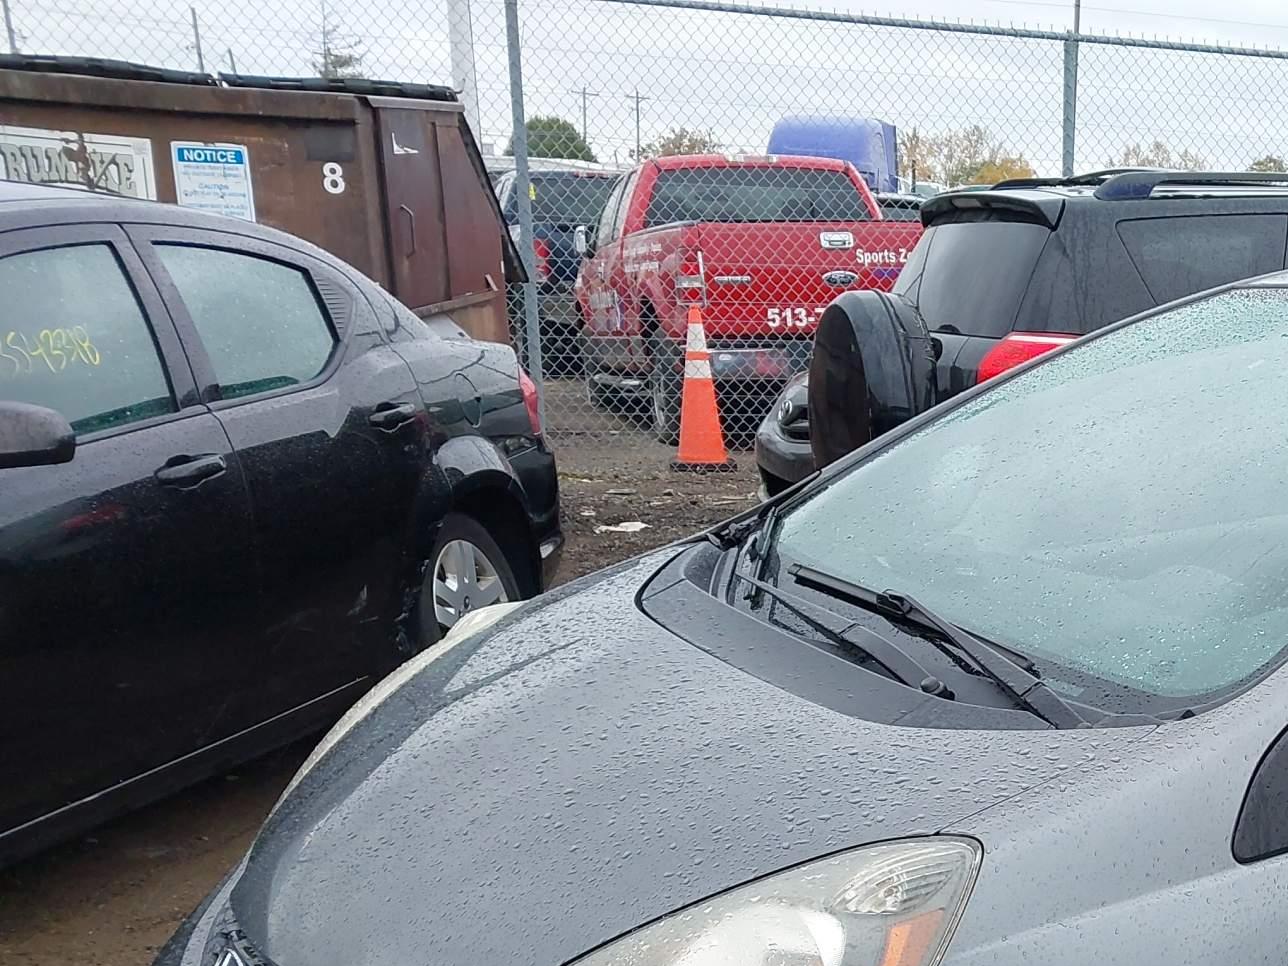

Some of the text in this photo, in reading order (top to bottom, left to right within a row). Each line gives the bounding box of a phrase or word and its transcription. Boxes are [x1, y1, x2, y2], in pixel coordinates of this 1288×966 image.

[183, 149, 237, 163] NOTICE
[0, 143, 138, 198] RUMKE
[323, 162, 345, 193] 8
[856, 248, 896, 266] Sports
